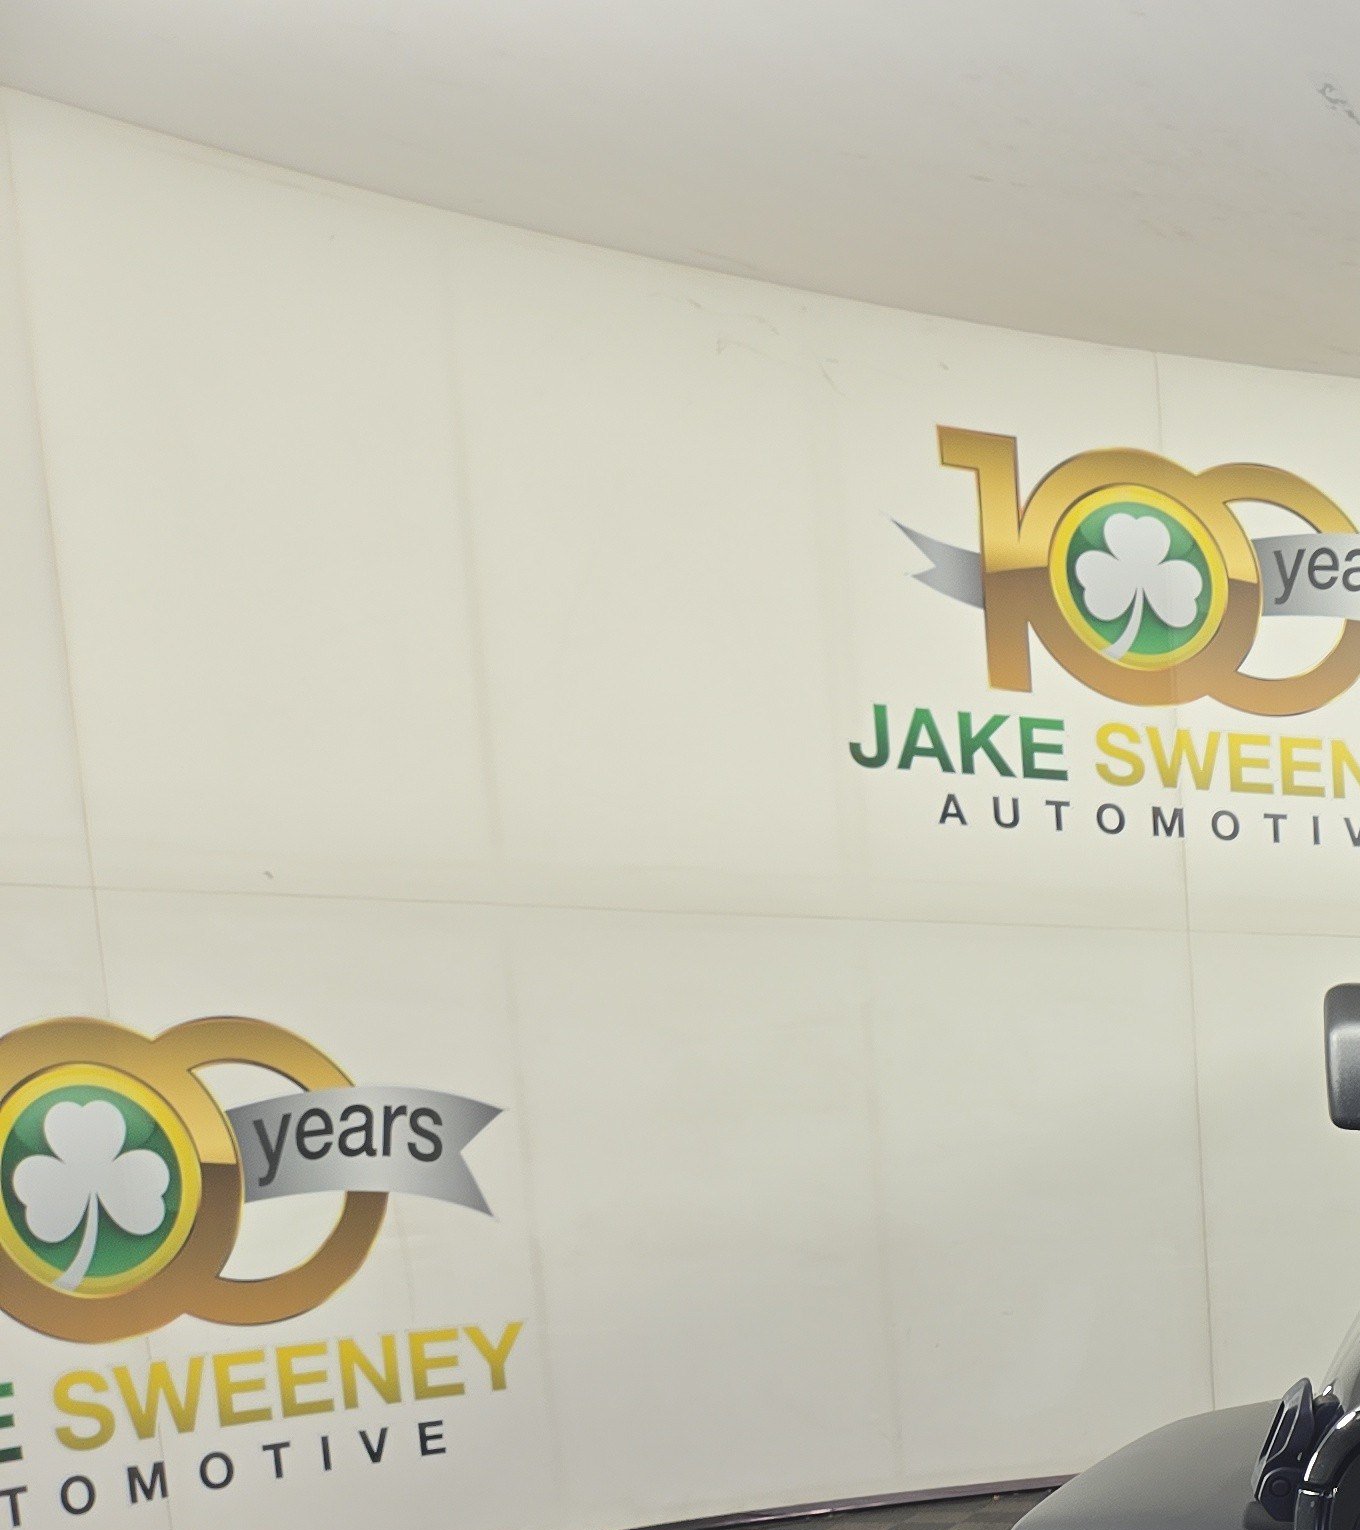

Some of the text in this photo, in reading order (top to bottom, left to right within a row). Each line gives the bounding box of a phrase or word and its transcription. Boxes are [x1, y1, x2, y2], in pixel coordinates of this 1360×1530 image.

[848, 703, 1069, 781] JAKE
[253, 1104, 443, 1186] years
[52, 1321, 523, 1451] SWEENEY
[0, 1420, 447, 1527] TOMOTIVE
